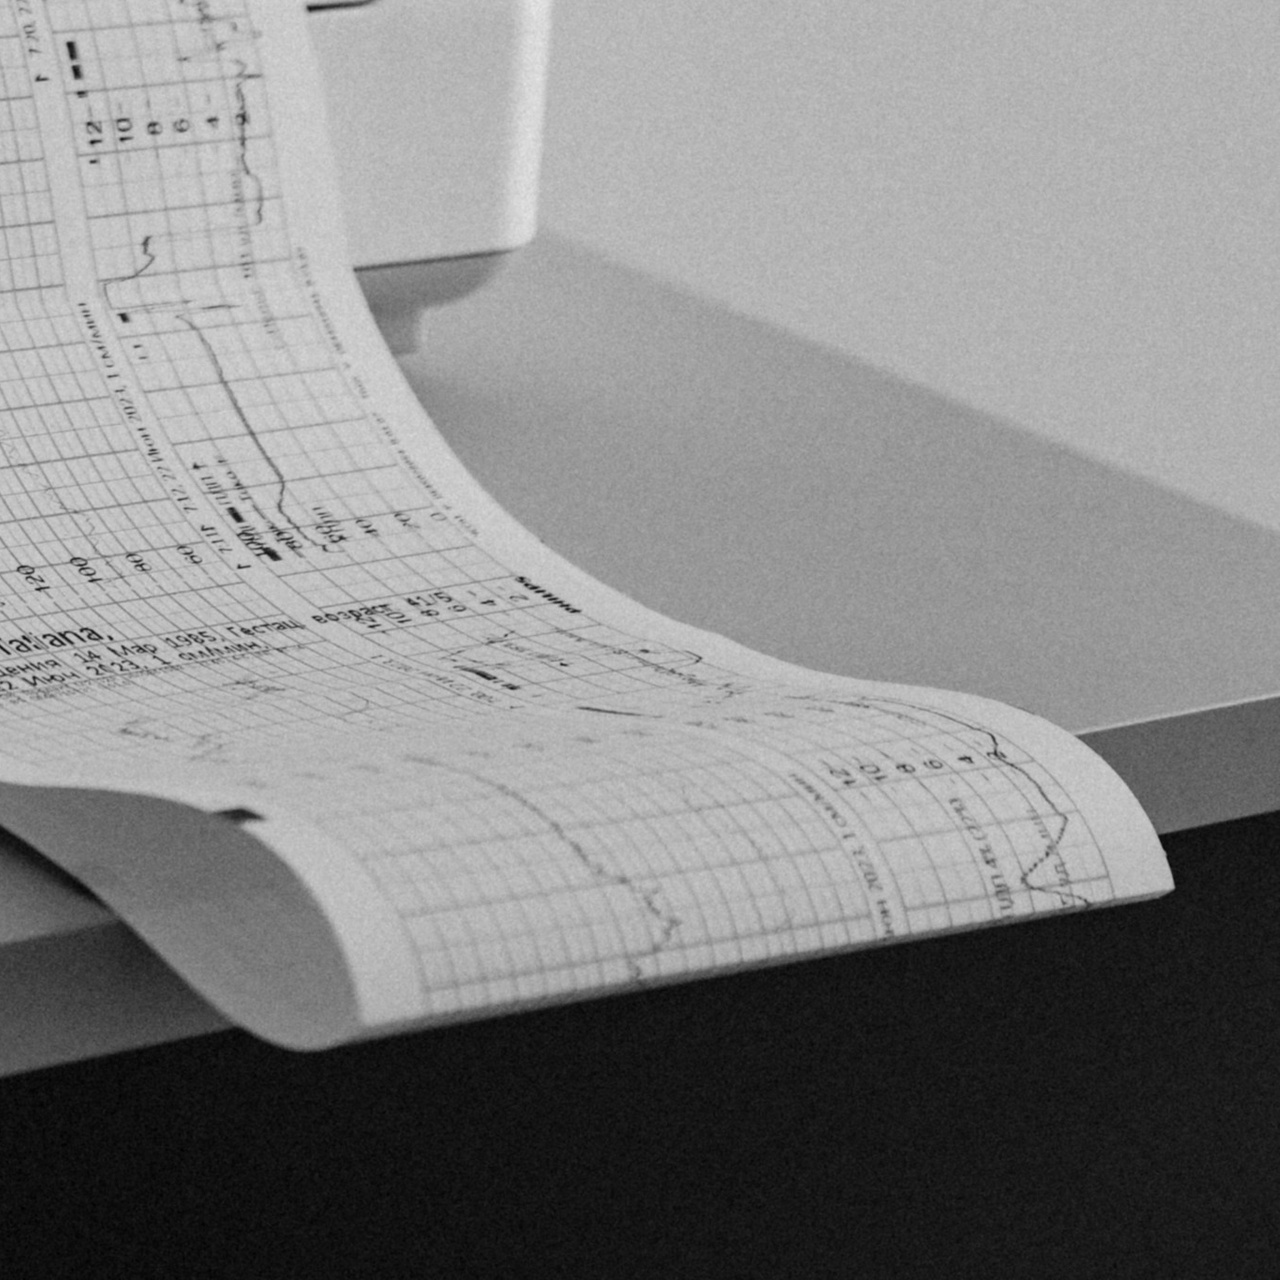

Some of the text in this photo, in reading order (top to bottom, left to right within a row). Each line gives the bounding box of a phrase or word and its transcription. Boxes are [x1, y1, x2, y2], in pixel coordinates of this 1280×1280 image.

[85, 120, 103, 146] 12
[116, 117, 134, 142] 10
[147, 121, 163, 135] 8
[173, 118, 190, 134] 6
[125, 552, 152, 573] 80
[176, 544, 204, 566] 60
[17, 564, 51, 593] 120
[70, 556, 103, 584] 100
[74, 649, 102, 665] 14
[107, 642, 158, 659] Мар
[22, 670, 81, 688] Июн
[152, 653, 173, 667] 1
[860, 762, 888, 782] 10
[896, 762, 916, 775] 8
[923, 759, 944, 771] 6
